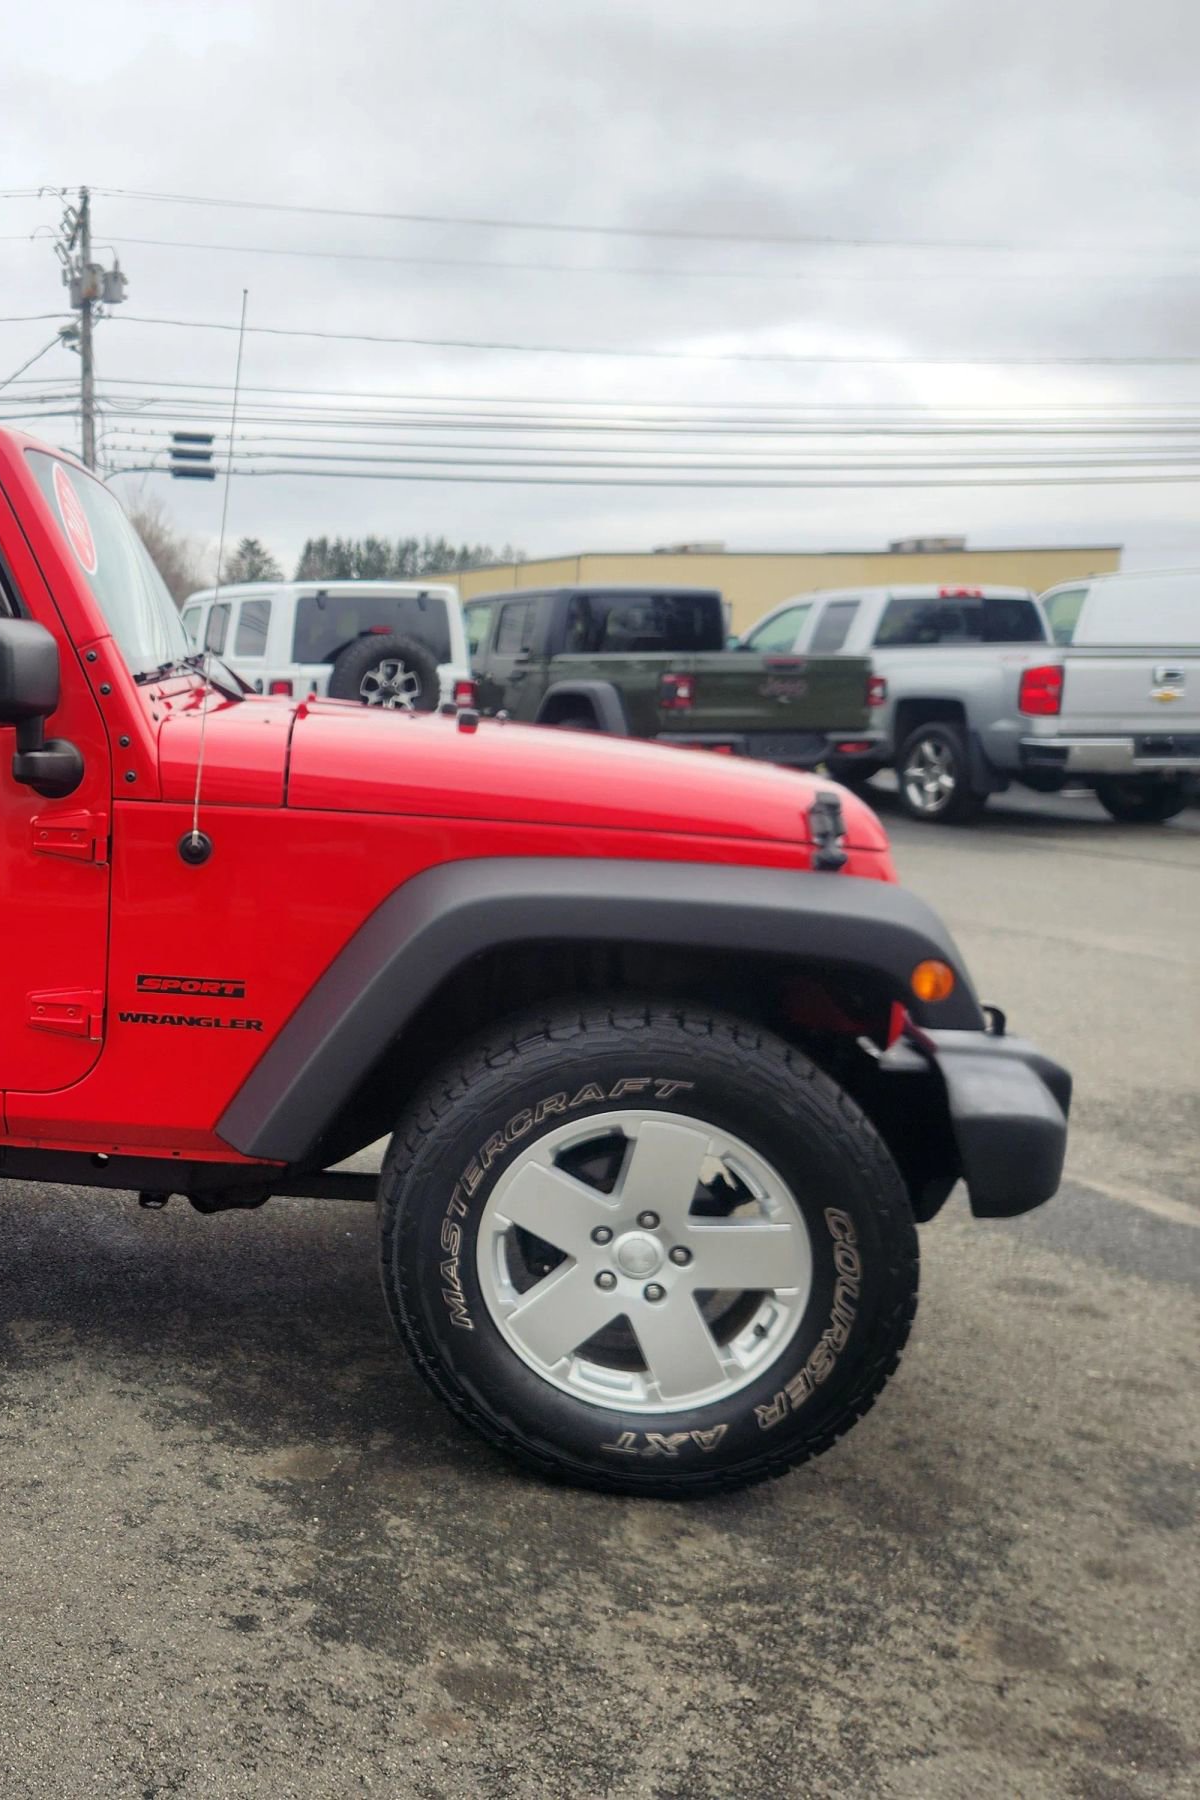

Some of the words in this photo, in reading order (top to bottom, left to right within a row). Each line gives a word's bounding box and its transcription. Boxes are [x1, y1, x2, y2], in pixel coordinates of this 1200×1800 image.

[141, 977, 241, 996] SPORT
[118, 1011, 264, 1032] WRANGLER
[439, 1077, 696, 1331] MASTERCRAFT
[752, 1206, 864, 1431] COURSER
[600, 1423, 730, 1456] AXT
